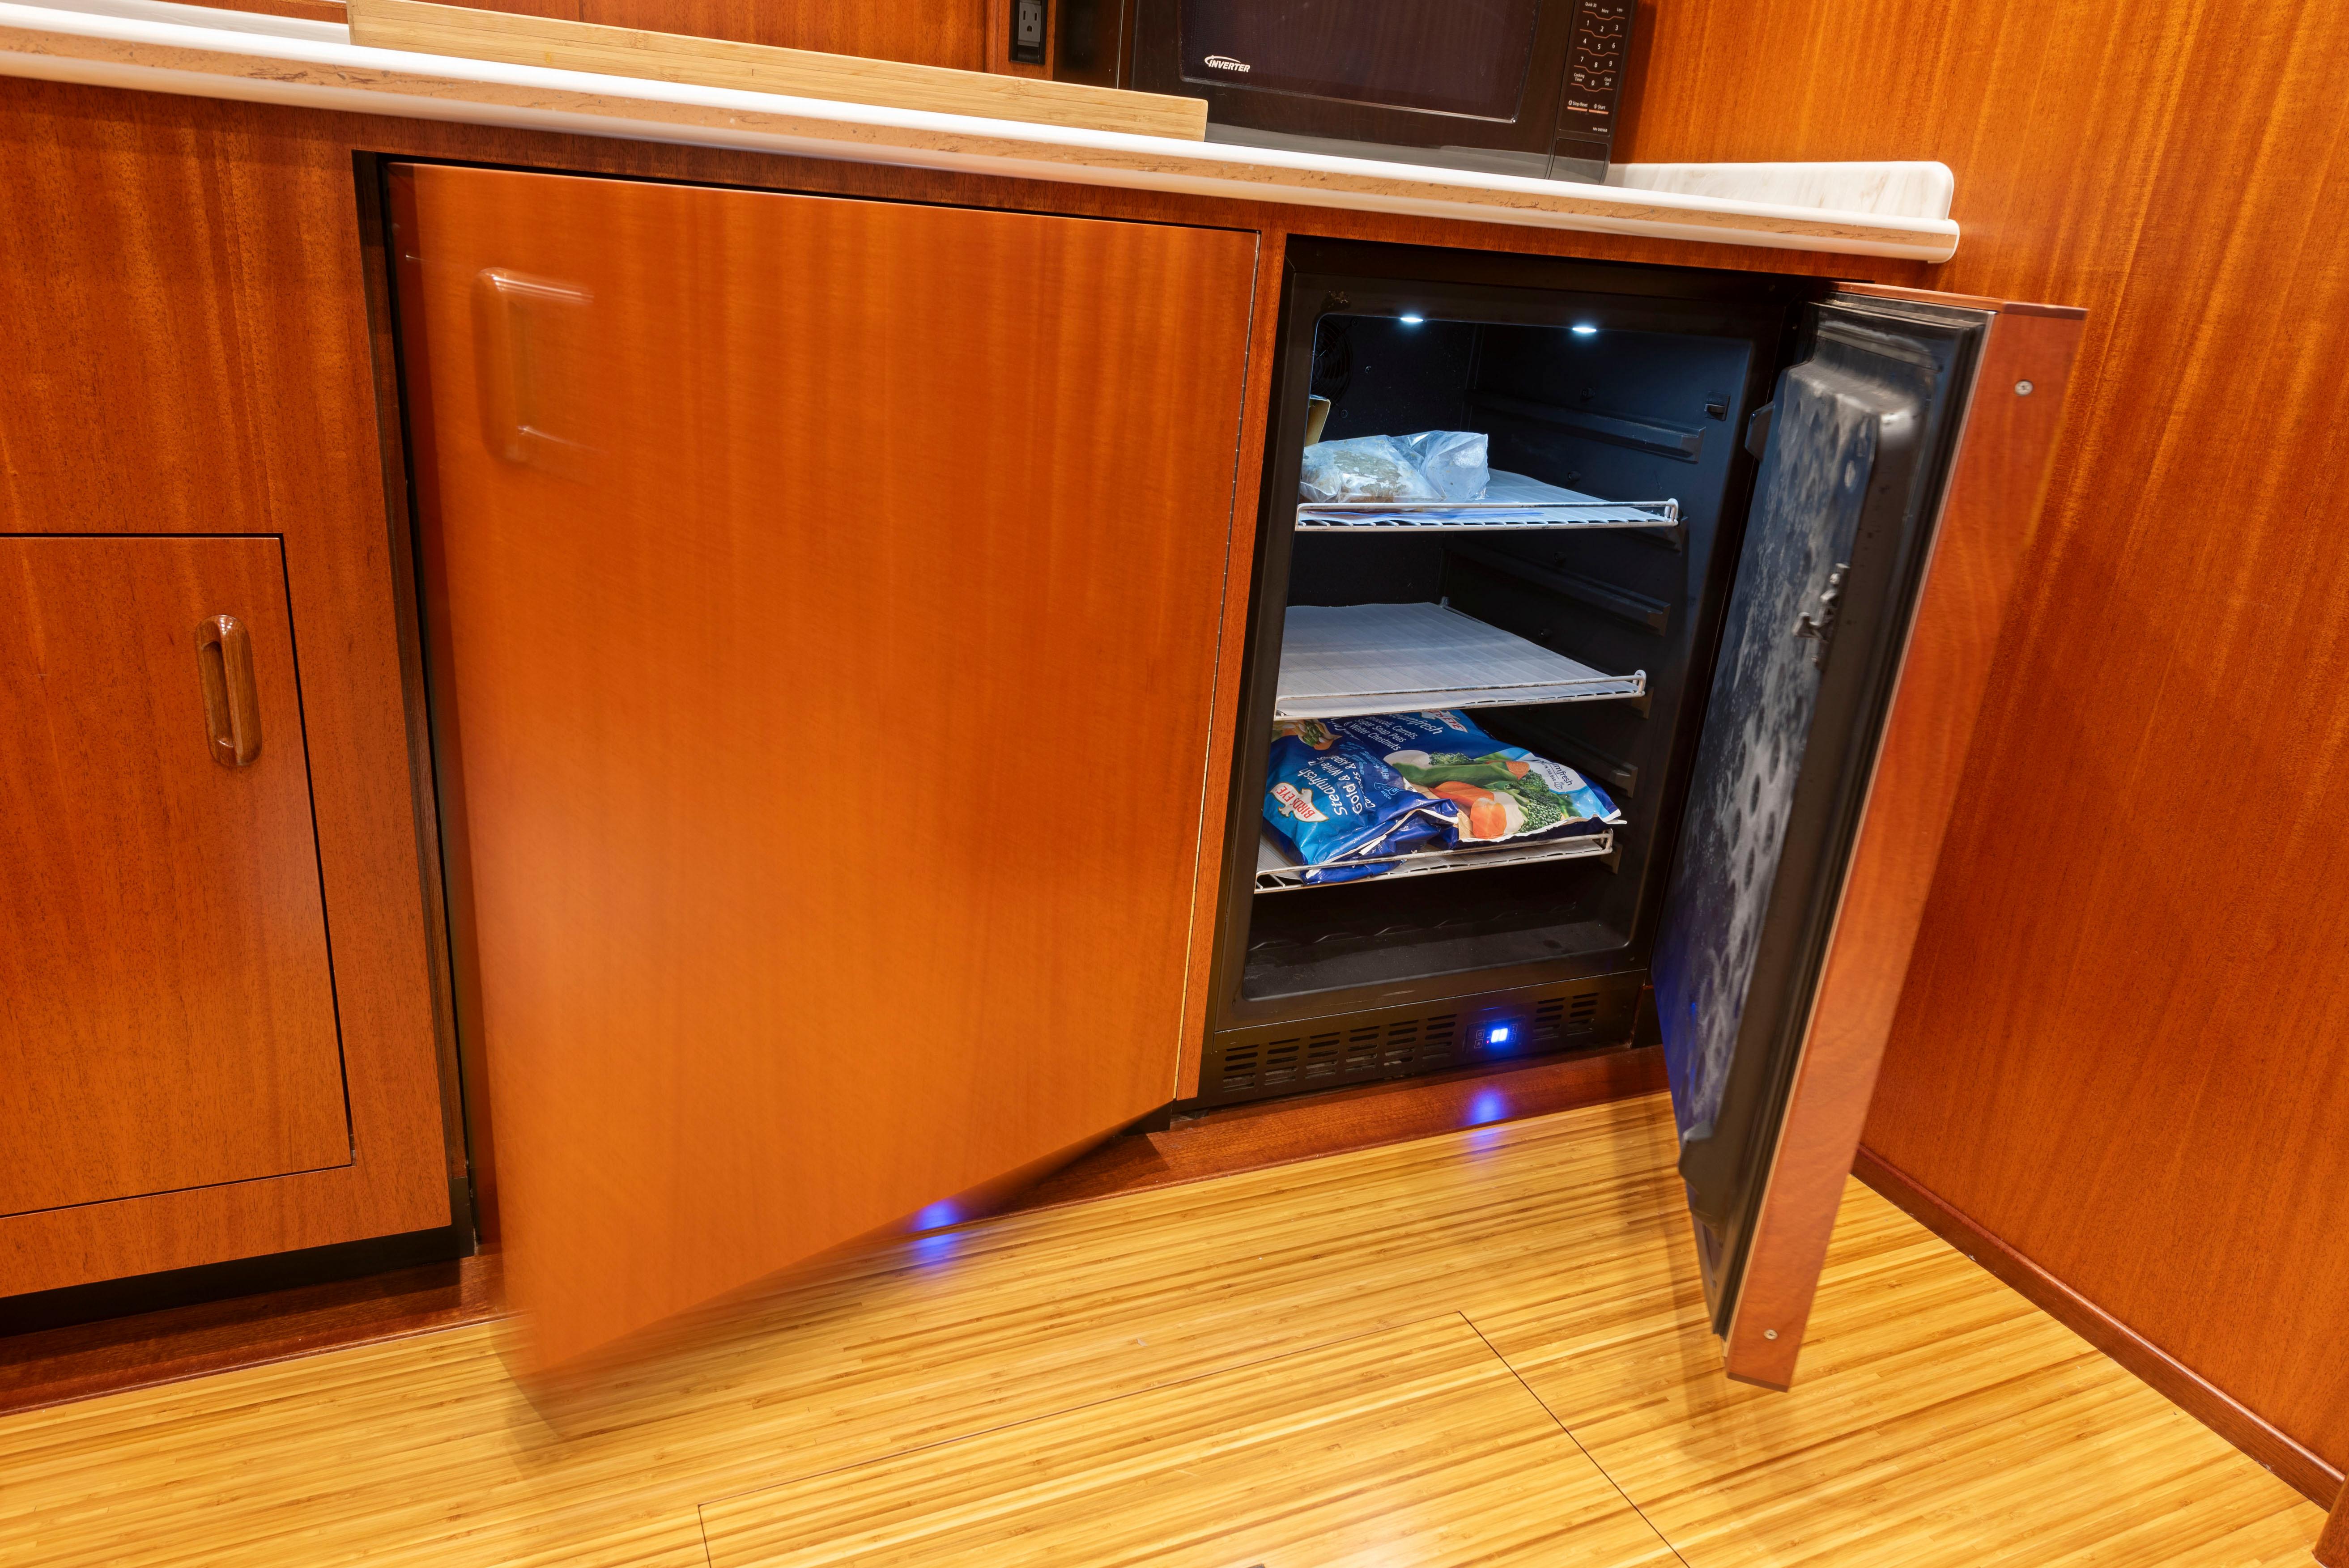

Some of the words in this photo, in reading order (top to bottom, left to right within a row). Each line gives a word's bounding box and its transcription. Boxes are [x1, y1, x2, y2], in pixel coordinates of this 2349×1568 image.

[1208, 60, 1251, 72] INVERTER
[1383, 713, 1443, 734] teamfresh
[1392, 725, 1418, 739] Carrots,
[1443, 717, 1464, 730] EYE
[1349, 723, 1370, 735] Water
[1368, 732, 1401, 751] Chestnuts
[1372, 725, 1391, 735] Snap
[1388, 733, 1407, 743] Peas
[1321, 762, 1343, 777] White
[1276, 786, 1295, 802] EYE
[1298, 769, 1348, 816] Steamfresh
[1343, 783, 1362, 814] Gold
[1290, 798, 1315, 819] BIRDS
